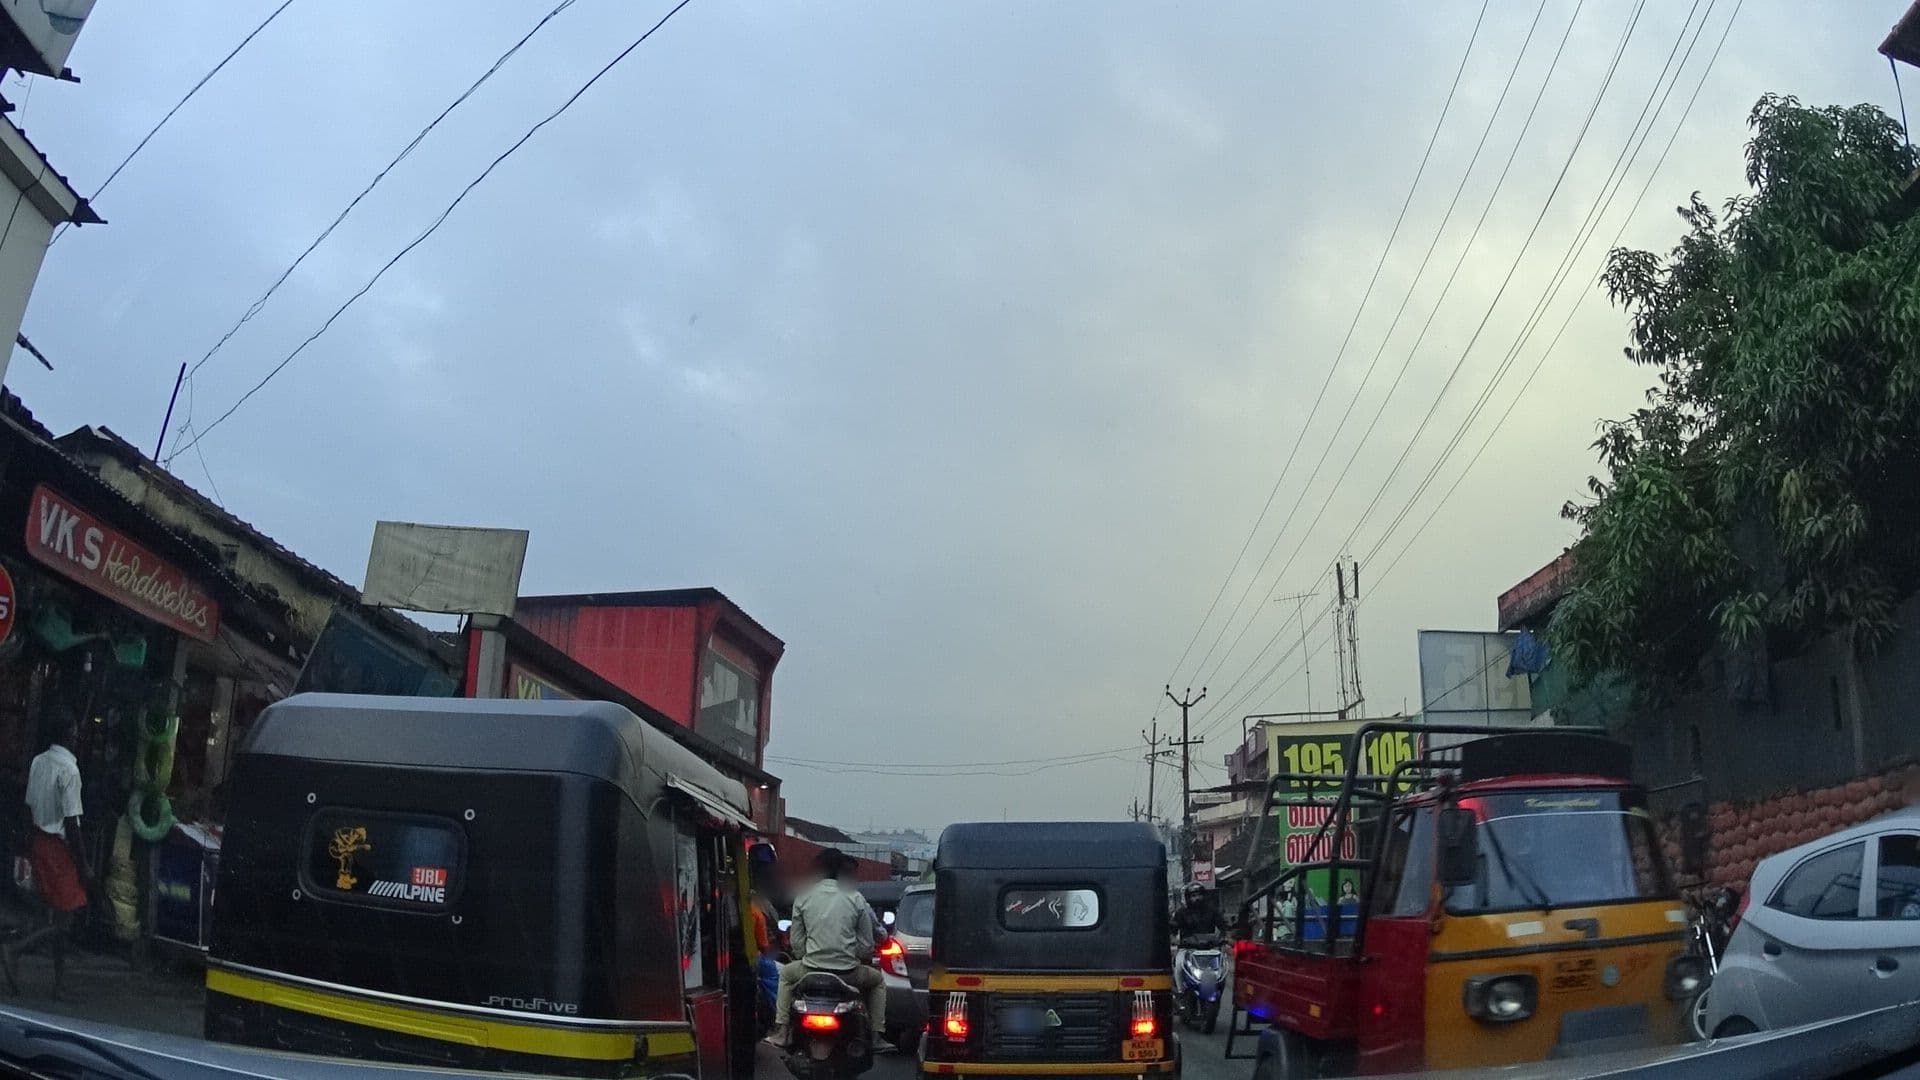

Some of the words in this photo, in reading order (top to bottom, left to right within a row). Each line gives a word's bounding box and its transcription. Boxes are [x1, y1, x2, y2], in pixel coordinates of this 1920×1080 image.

[101, 540, 208, 628] Hardwares
[1283, 741, 1345, 788] 195
[1368, 731, 1412, 794] 195
[387, 881, 446, 904] ALPINE
[415, 869, 444, 885] JBL
